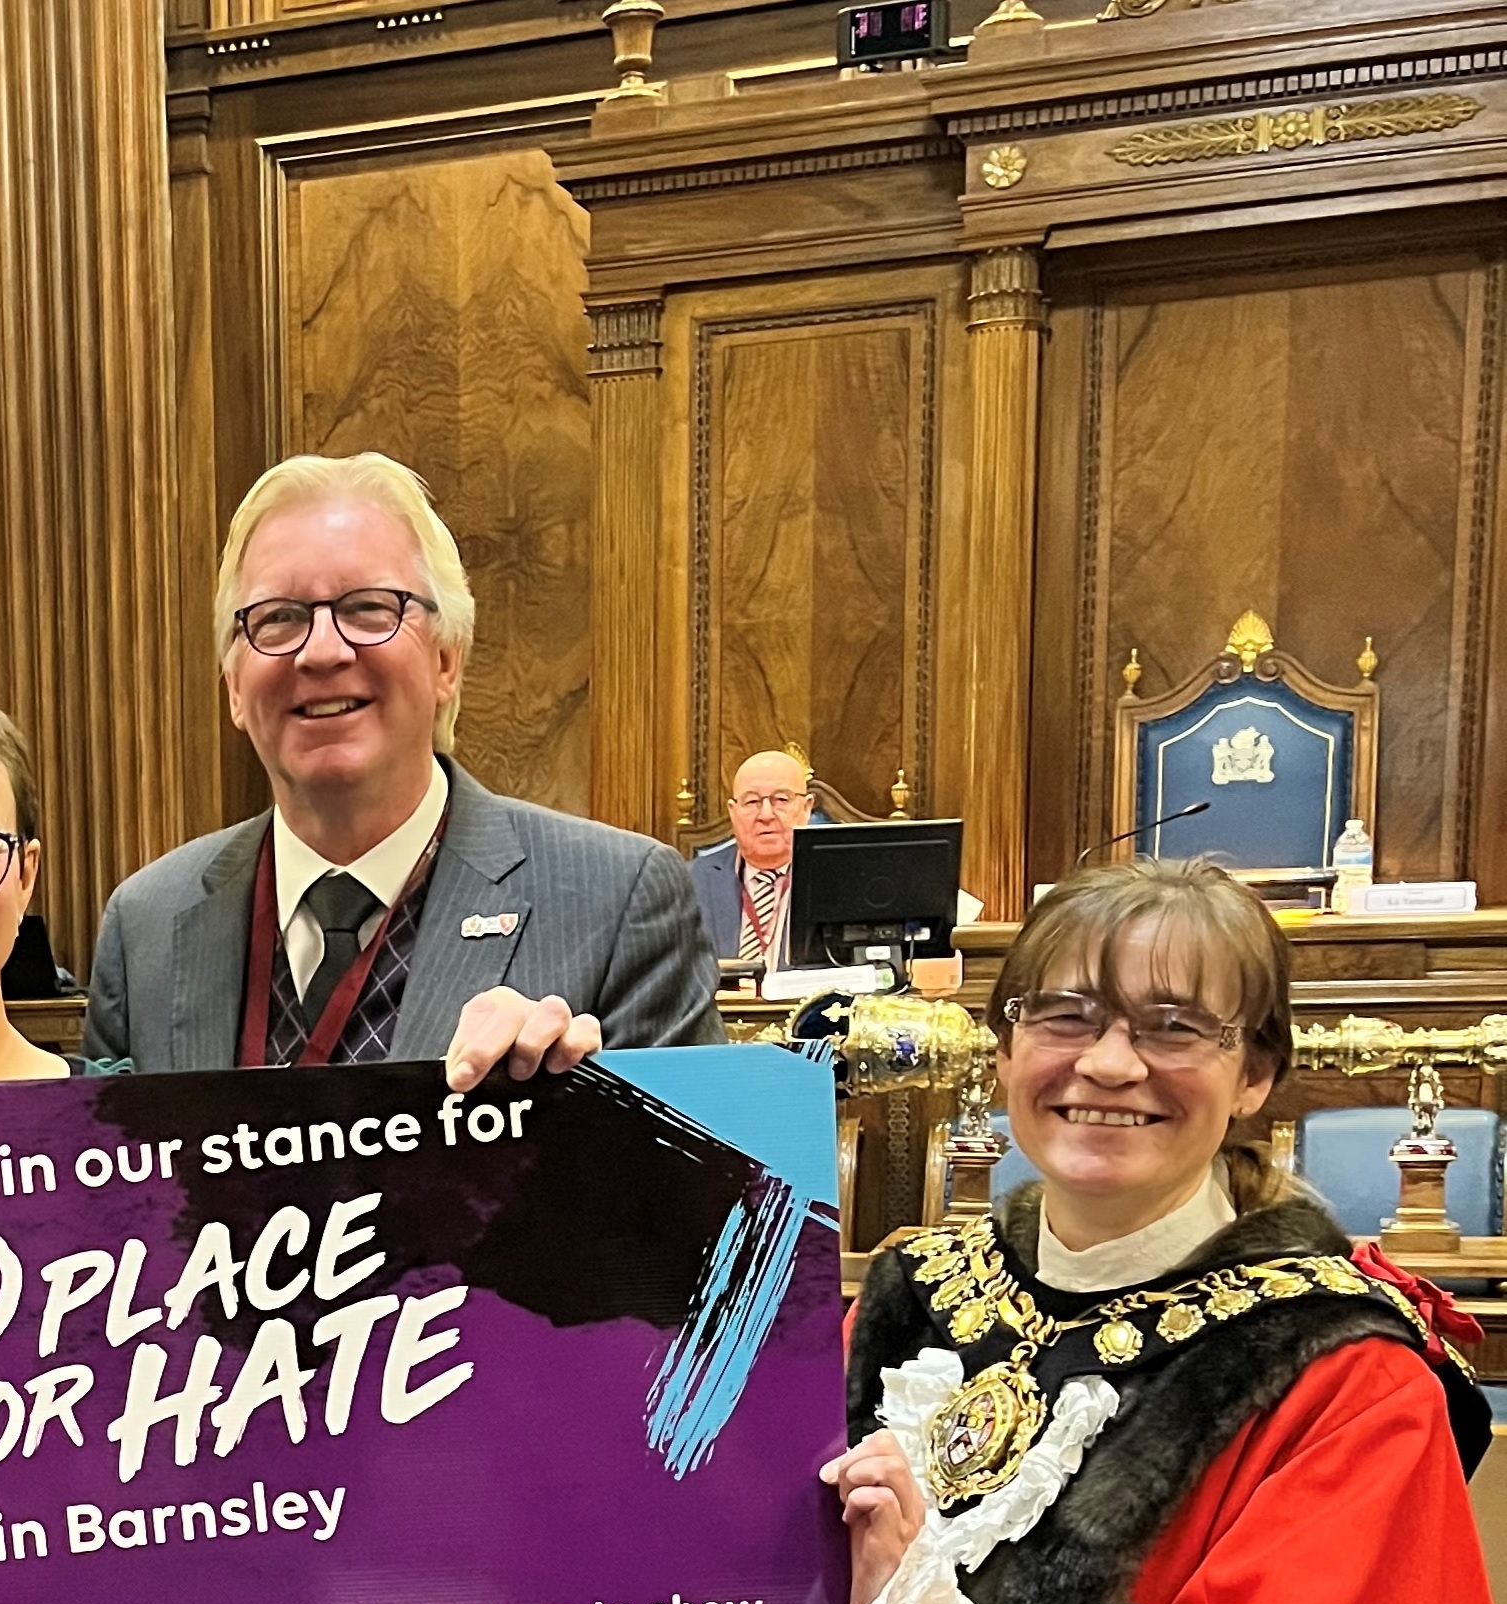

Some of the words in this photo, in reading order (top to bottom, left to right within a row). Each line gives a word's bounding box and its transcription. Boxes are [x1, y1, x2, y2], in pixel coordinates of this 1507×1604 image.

[74, 1138, 183, 1188] our
[201, 1113, 422, 1174] stance
[437, 1093, 533, 1146] for
[38, 1192, 386, 1358] PLACE
[106, 1285, 475, 1484] HATE
[66, 1481, 346, 1554] Barnsley
